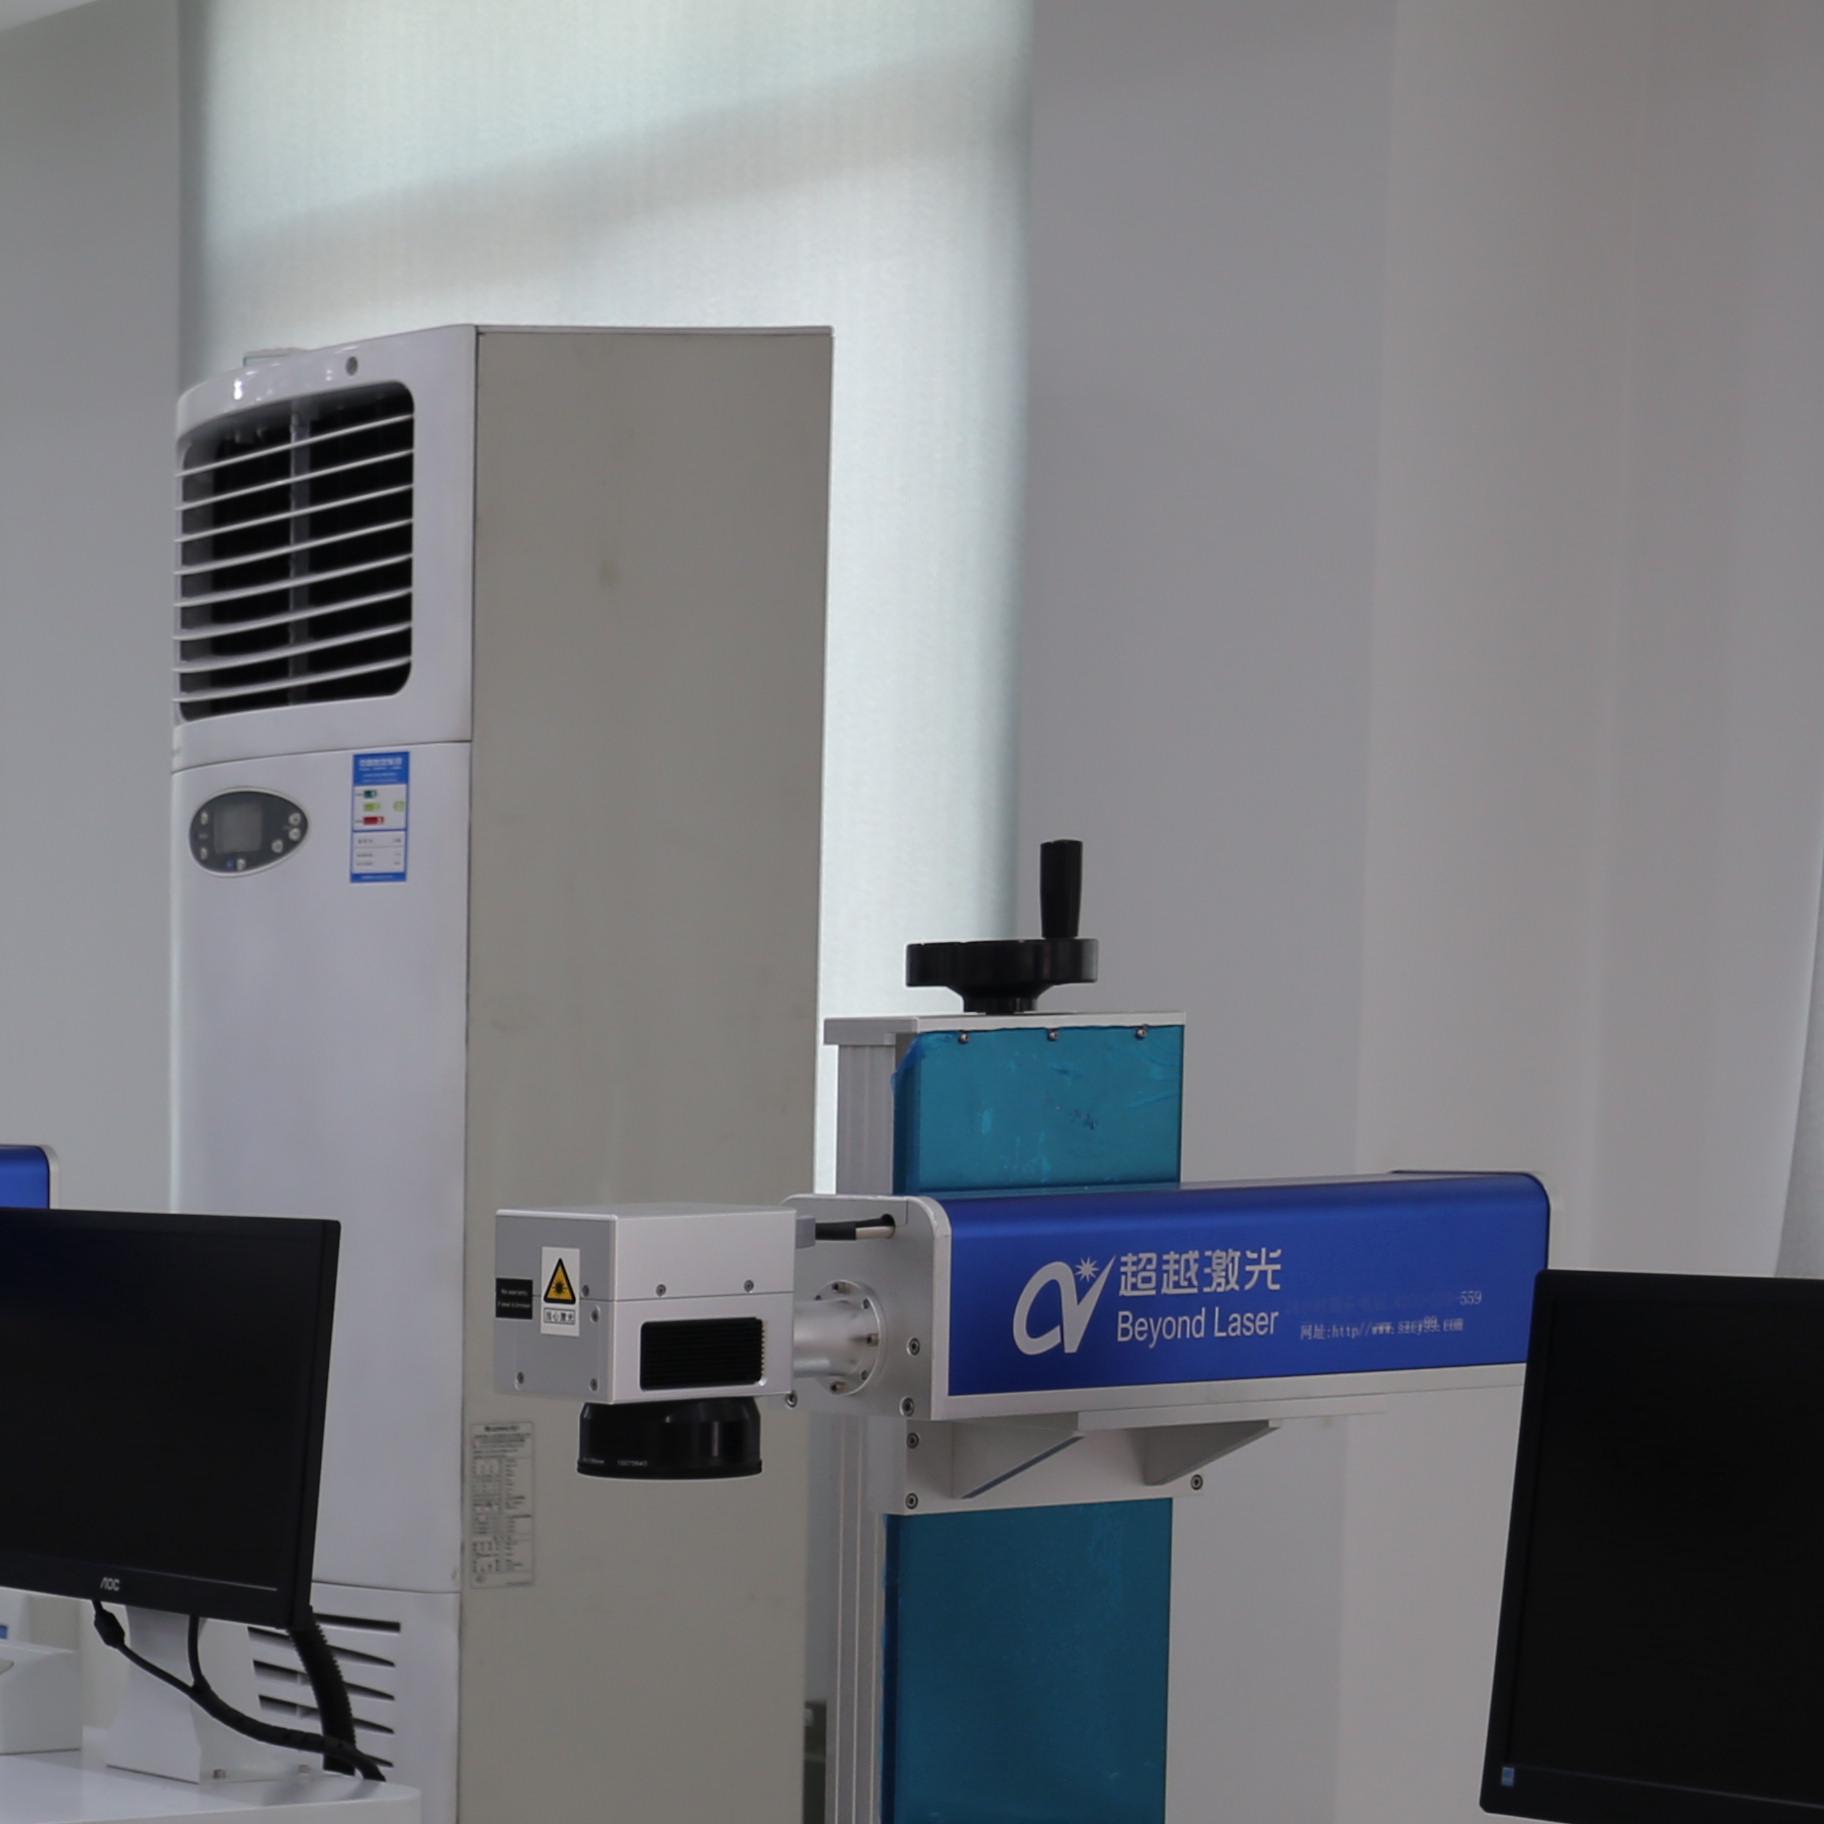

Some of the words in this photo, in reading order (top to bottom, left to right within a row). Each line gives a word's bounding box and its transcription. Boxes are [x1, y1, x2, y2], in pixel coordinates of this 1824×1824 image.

[1118, 1247, 1282, 1297] 超越激光
[1117, 1307, 1206, 1348] Beyond
[1214, 1305, 1279, 1337] Laser
[99, 1576, 120, 1592] AOC
